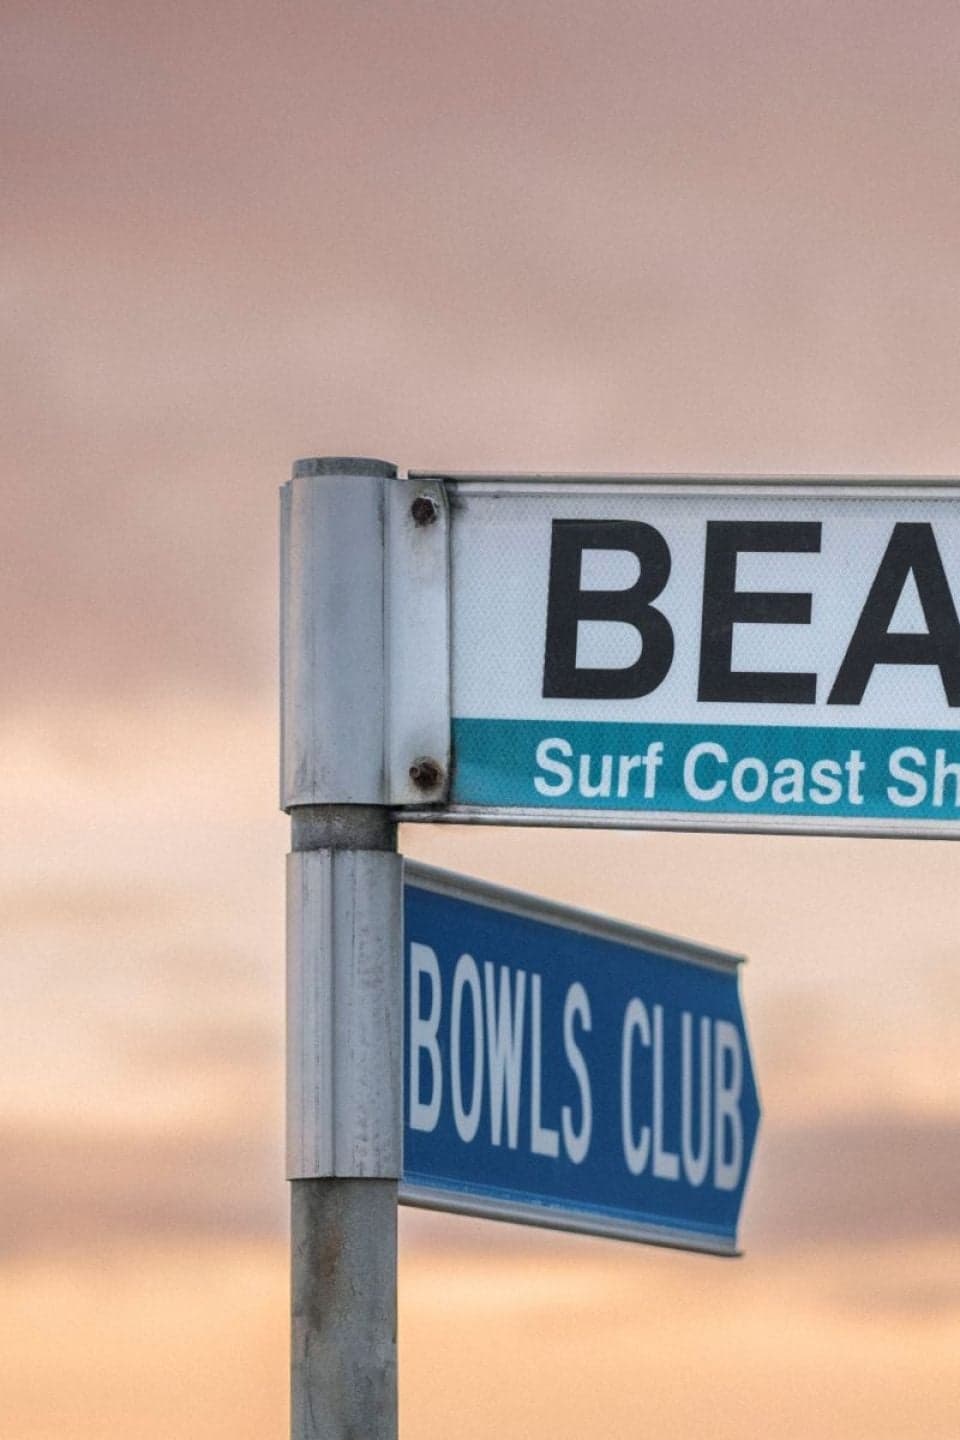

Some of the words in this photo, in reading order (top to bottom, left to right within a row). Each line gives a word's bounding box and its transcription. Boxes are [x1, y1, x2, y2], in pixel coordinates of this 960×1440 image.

[533, 737, 662, 800] Surf
[683, 742, 866, 805] Coast
[409, 941, 593, 1165] BOWLS
[621, 997, 744, 1192] CLUB
